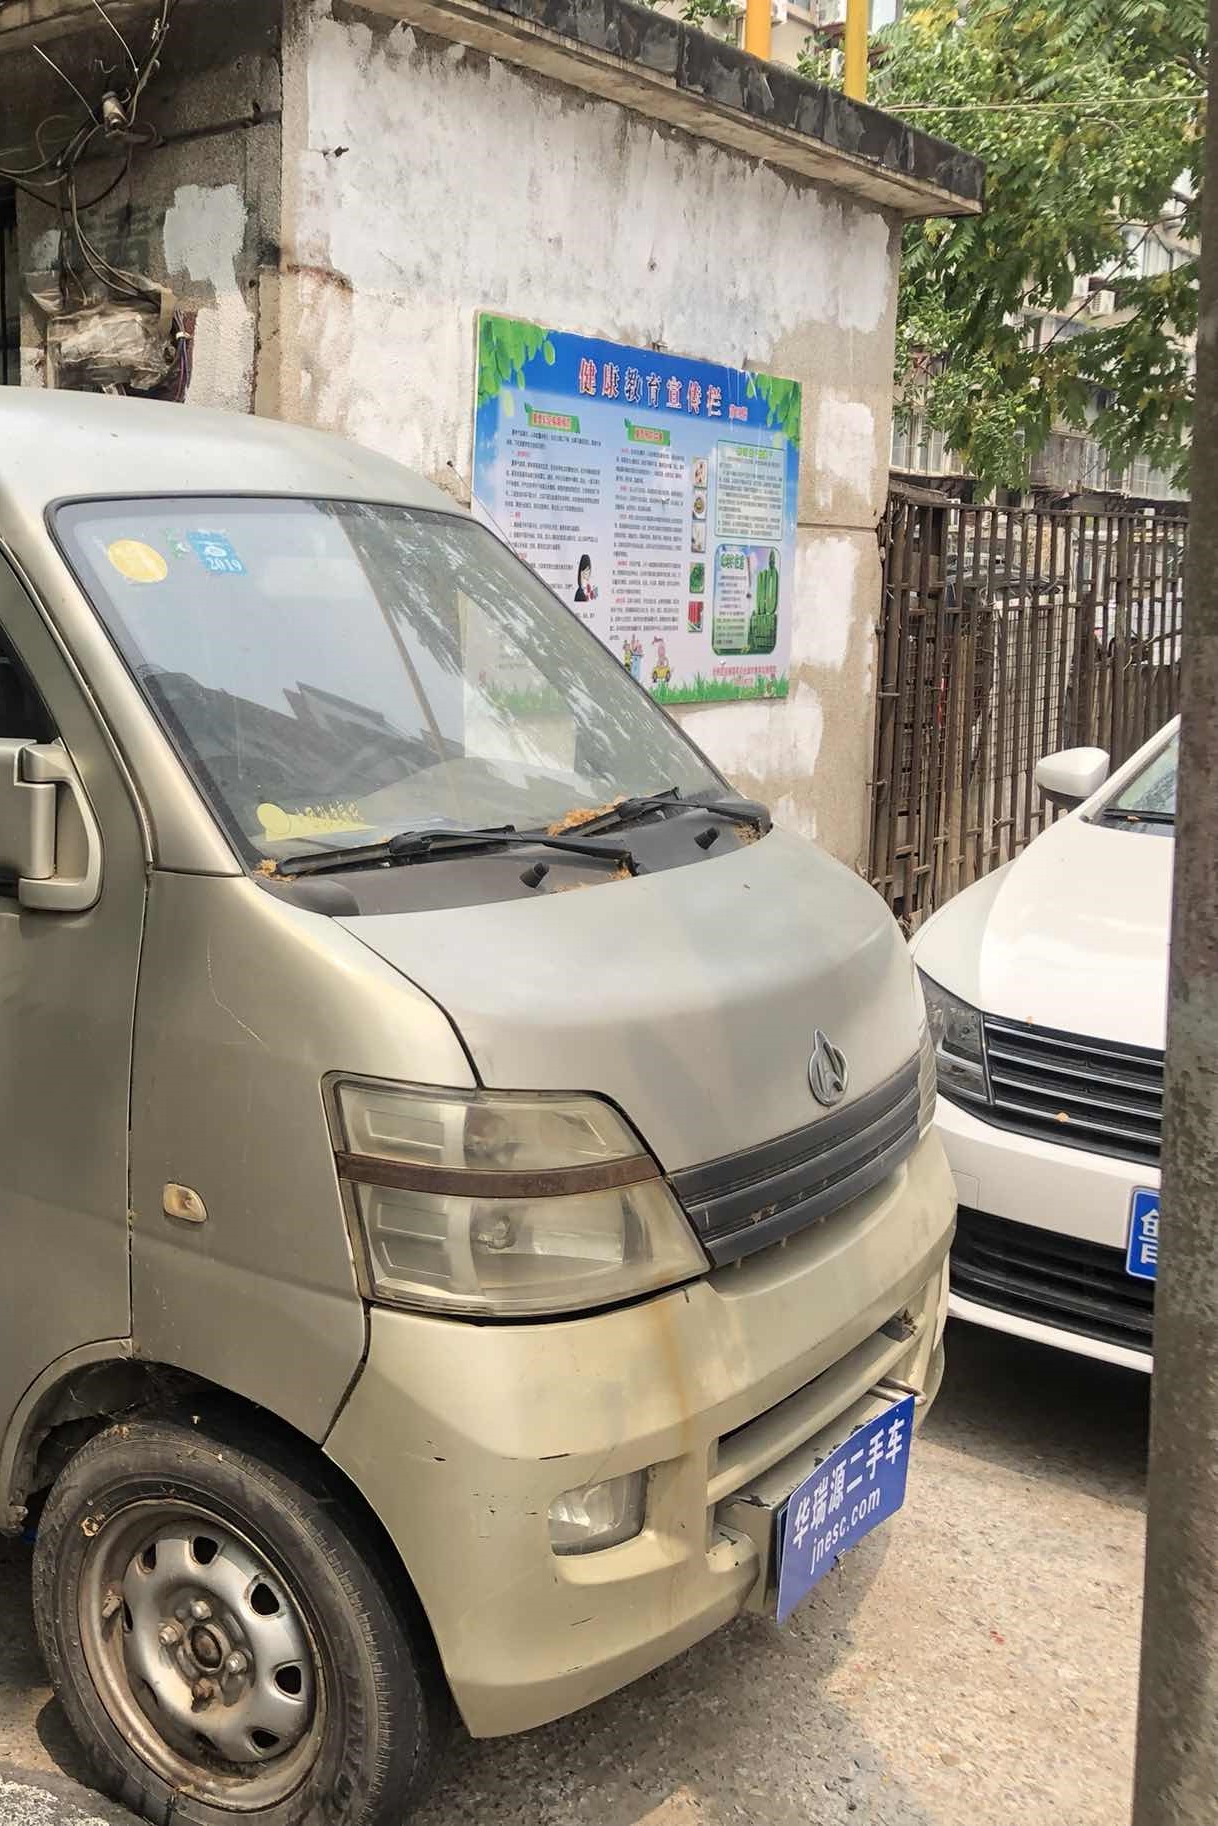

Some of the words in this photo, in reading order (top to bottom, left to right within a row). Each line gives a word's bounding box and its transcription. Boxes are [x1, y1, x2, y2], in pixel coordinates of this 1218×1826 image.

[793, 1418, 905, 1549] 华瑞源二手车
[810, 1487, 881, 1576] jnesc.com
